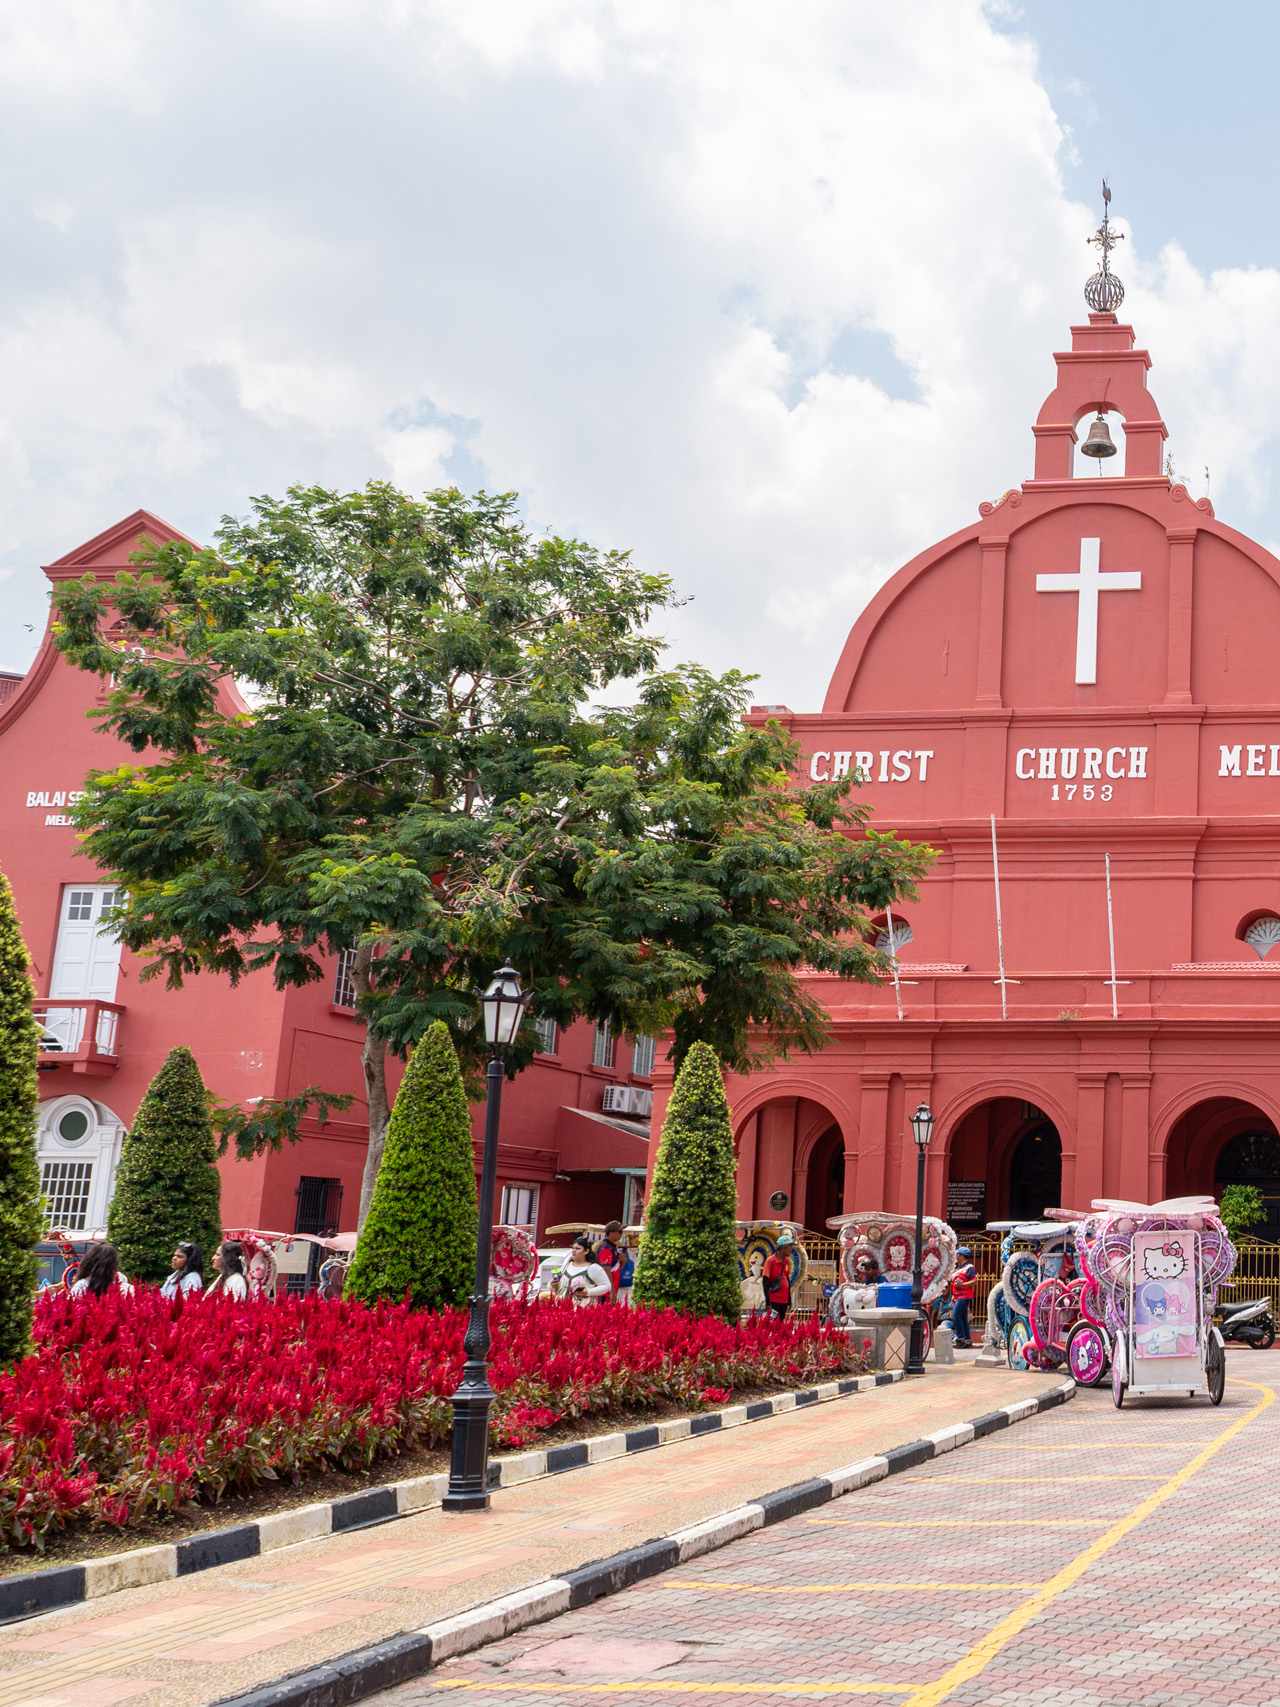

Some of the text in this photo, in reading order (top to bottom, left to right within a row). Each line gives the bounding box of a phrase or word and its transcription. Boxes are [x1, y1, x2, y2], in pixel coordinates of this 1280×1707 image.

[810, 750, 934, 783] CHRIST
[1015, 746, 1149, 780] CHURCH
[26, 791, 66, 808] BALAI
[1051, 783, 1114, 802] 1753
